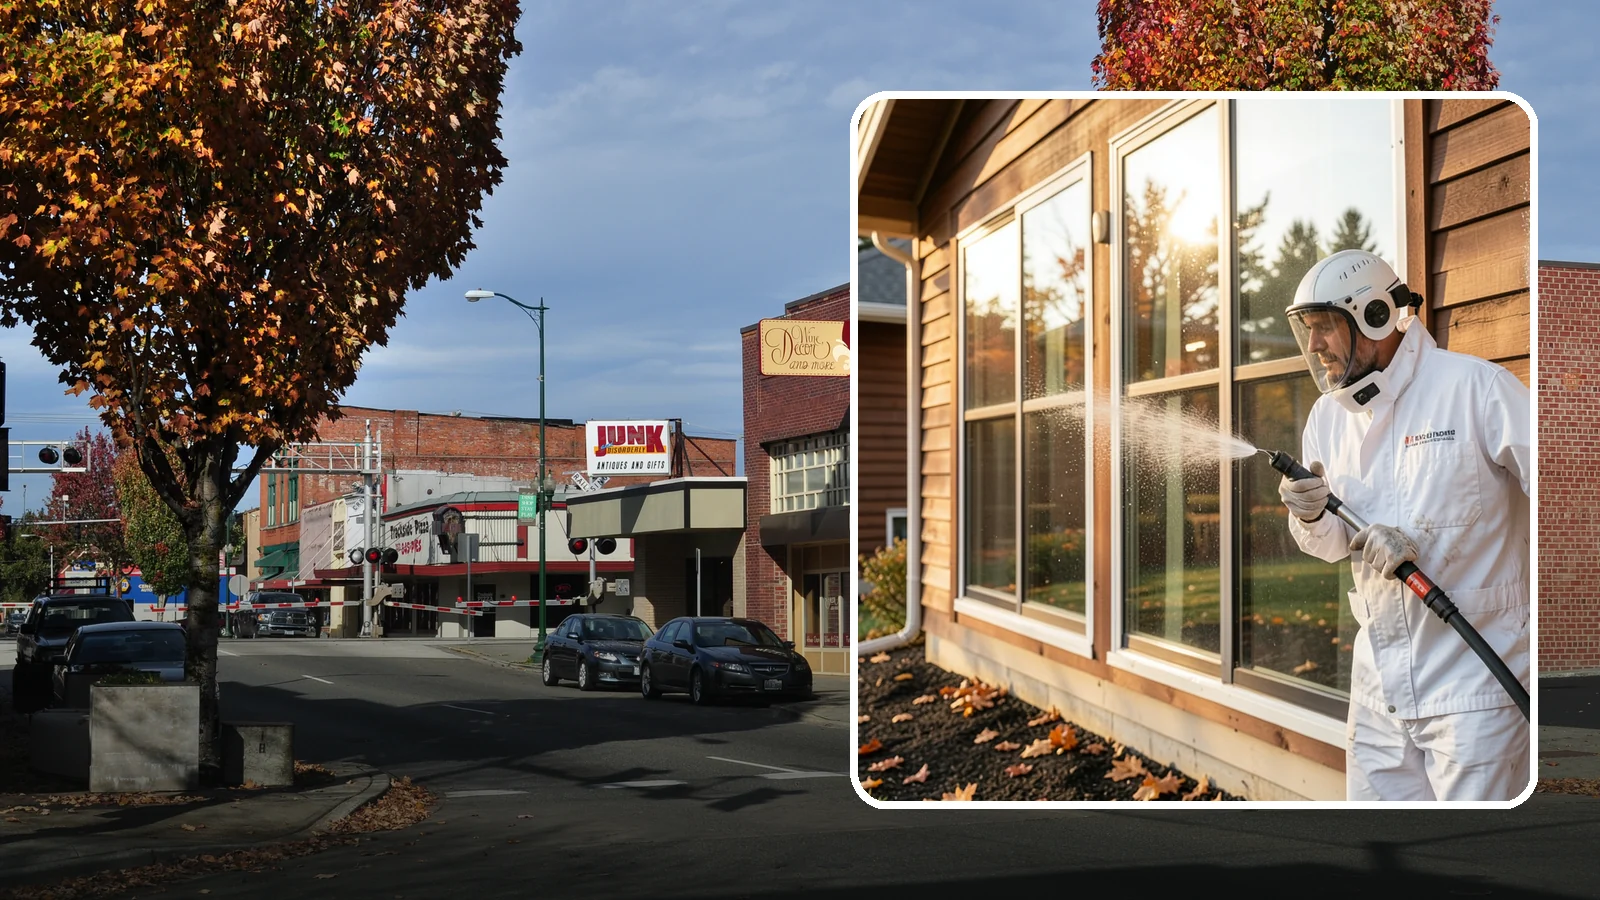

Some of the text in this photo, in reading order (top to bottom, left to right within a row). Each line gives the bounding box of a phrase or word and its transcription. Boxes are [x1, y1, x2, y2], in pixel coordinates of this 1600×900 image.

[764, 327, 831, 365] Decor
[595, 425, 664, 457] JUNK
[607, 446, 646, 454] DISORDERLY
[596, 460, 665, 470] ANTIQUES AND GIFTS
[390, 519, 429, 539] Trackside Pizza
